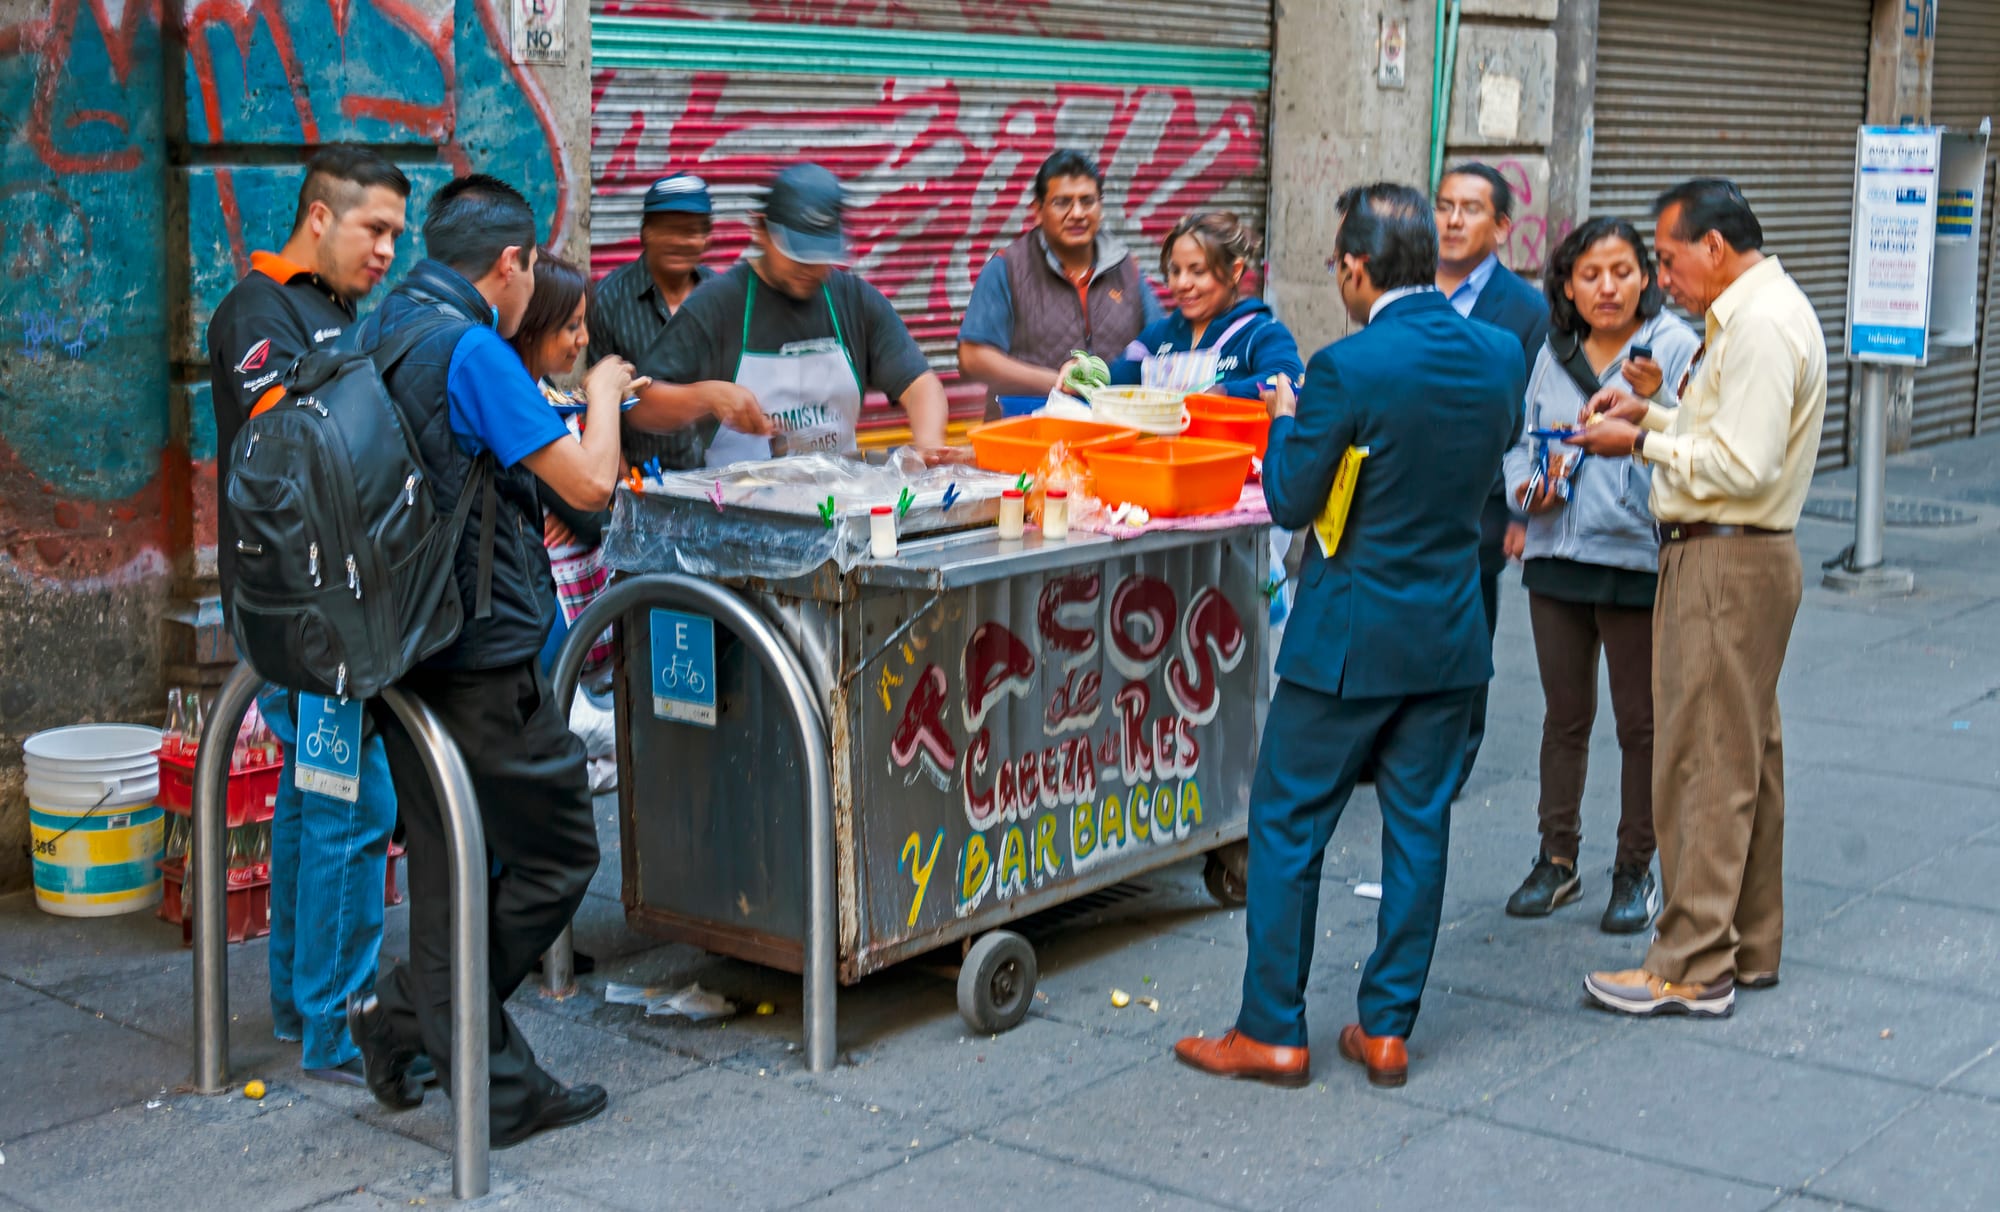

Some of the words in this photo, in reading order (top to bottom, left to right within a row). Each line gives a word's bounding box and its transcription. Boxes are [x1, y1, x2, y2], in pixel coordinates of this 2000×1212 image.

[527, 30, 552, 49] NO
[1898, 146, 1928, 157] Digital
[675, 622, 689, 651] E
[889, 573, 1246, 780] TACOS
[1045, 667, 1102, 735] de
[961, 727, 1097, 831] CABEZA
[1112, 680, 1201, 786] RES
[897, 827, 945, 928] Y
